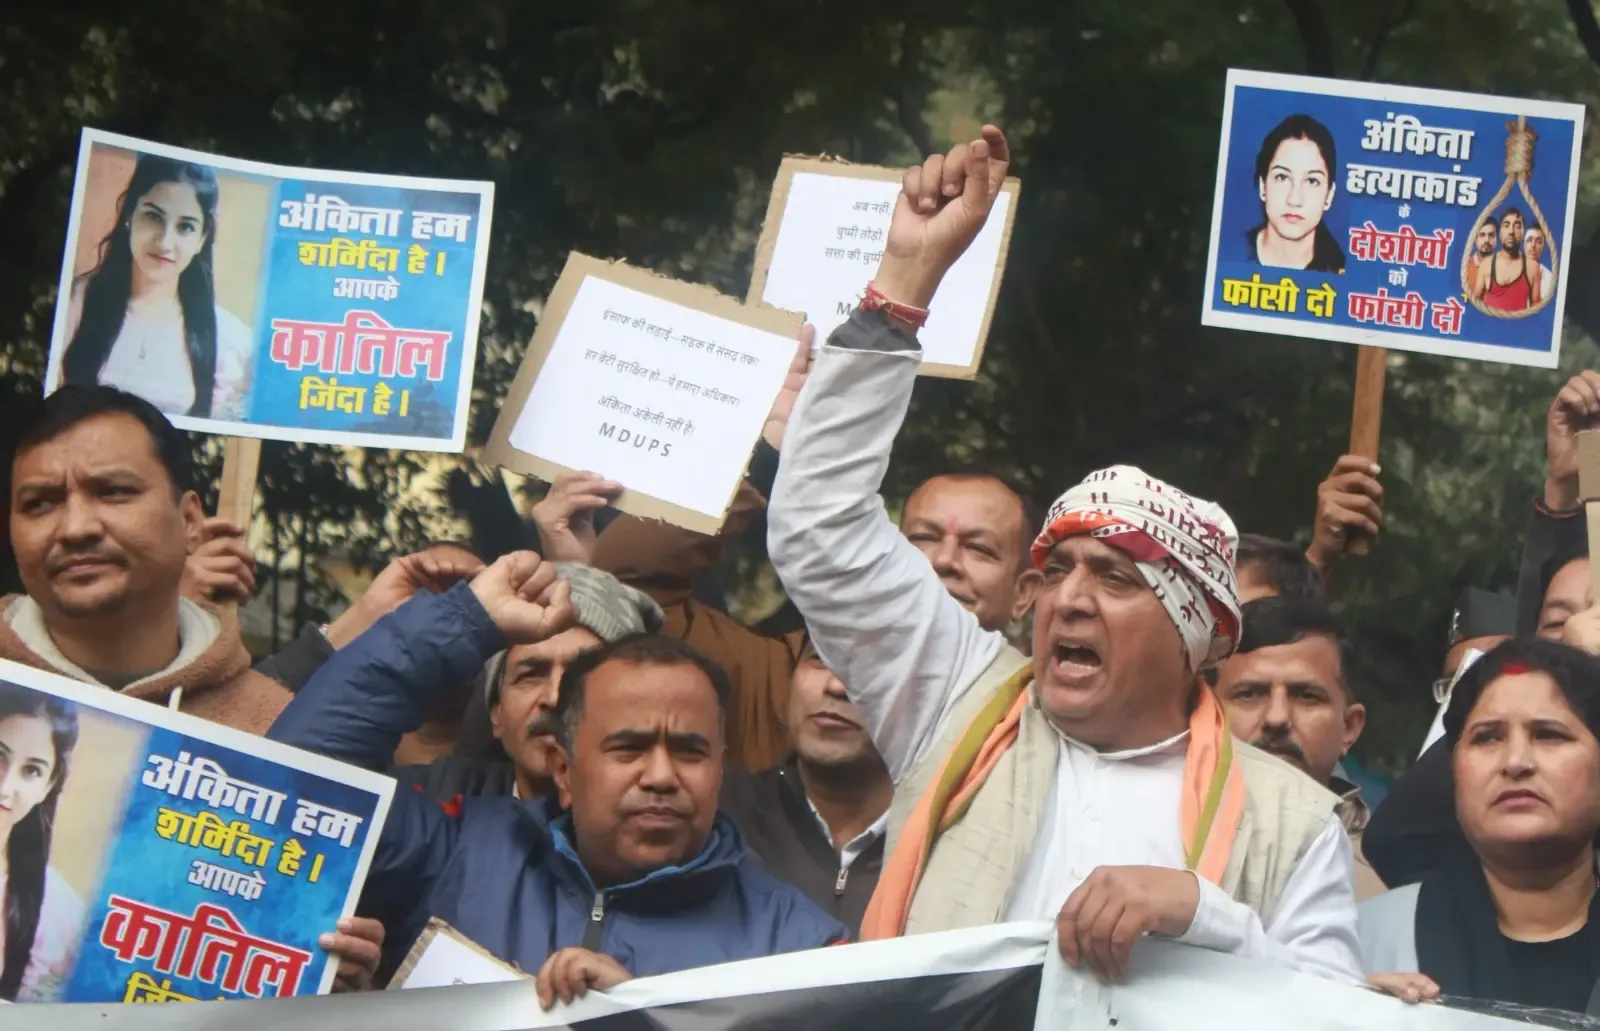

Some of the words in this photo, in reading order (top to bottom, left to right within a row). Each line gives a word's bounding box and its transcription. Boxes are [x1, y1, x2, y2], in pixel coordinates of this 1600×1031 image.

[1361, 112, 1475, 160] अंकिता
[1346, 163, 1482, 206] हत्याकांड
[279, 193, 403, 237] अंकिता
[411, 210, 471, 242] हम
[852, 201, 869, 213] अब
[1398, 203, 1411, 219] के
[298, 237, 400, 272] शर्मिंदा
[333, 276, 400, 301] आपके
[1223, 273, 1300, 313] फांसी
[1306, 282, 1337, 317] दो
[1388, 267, 1408, 287] को
[631, 317, 646, 332] की
[1348, 287, 1426, 330] फांसी
[1431, 297, 1465, 335] दो
[270, 309, 452, 381] कातिल
[584, 349, 598, 361] हर
[300, 376, 367, 413] जिंदा
[597, 395, 632, 414] अंकिता
[633, 408, 664, 427] अकेली
[142, 751, 288, 825] अंकिता
[291, 798, 364, 848] हम
[155, 807, 276, 867] शर्मिंदा
[187, 859, 266, 901] आपके
[99, 894, 313, 998] कातिल
